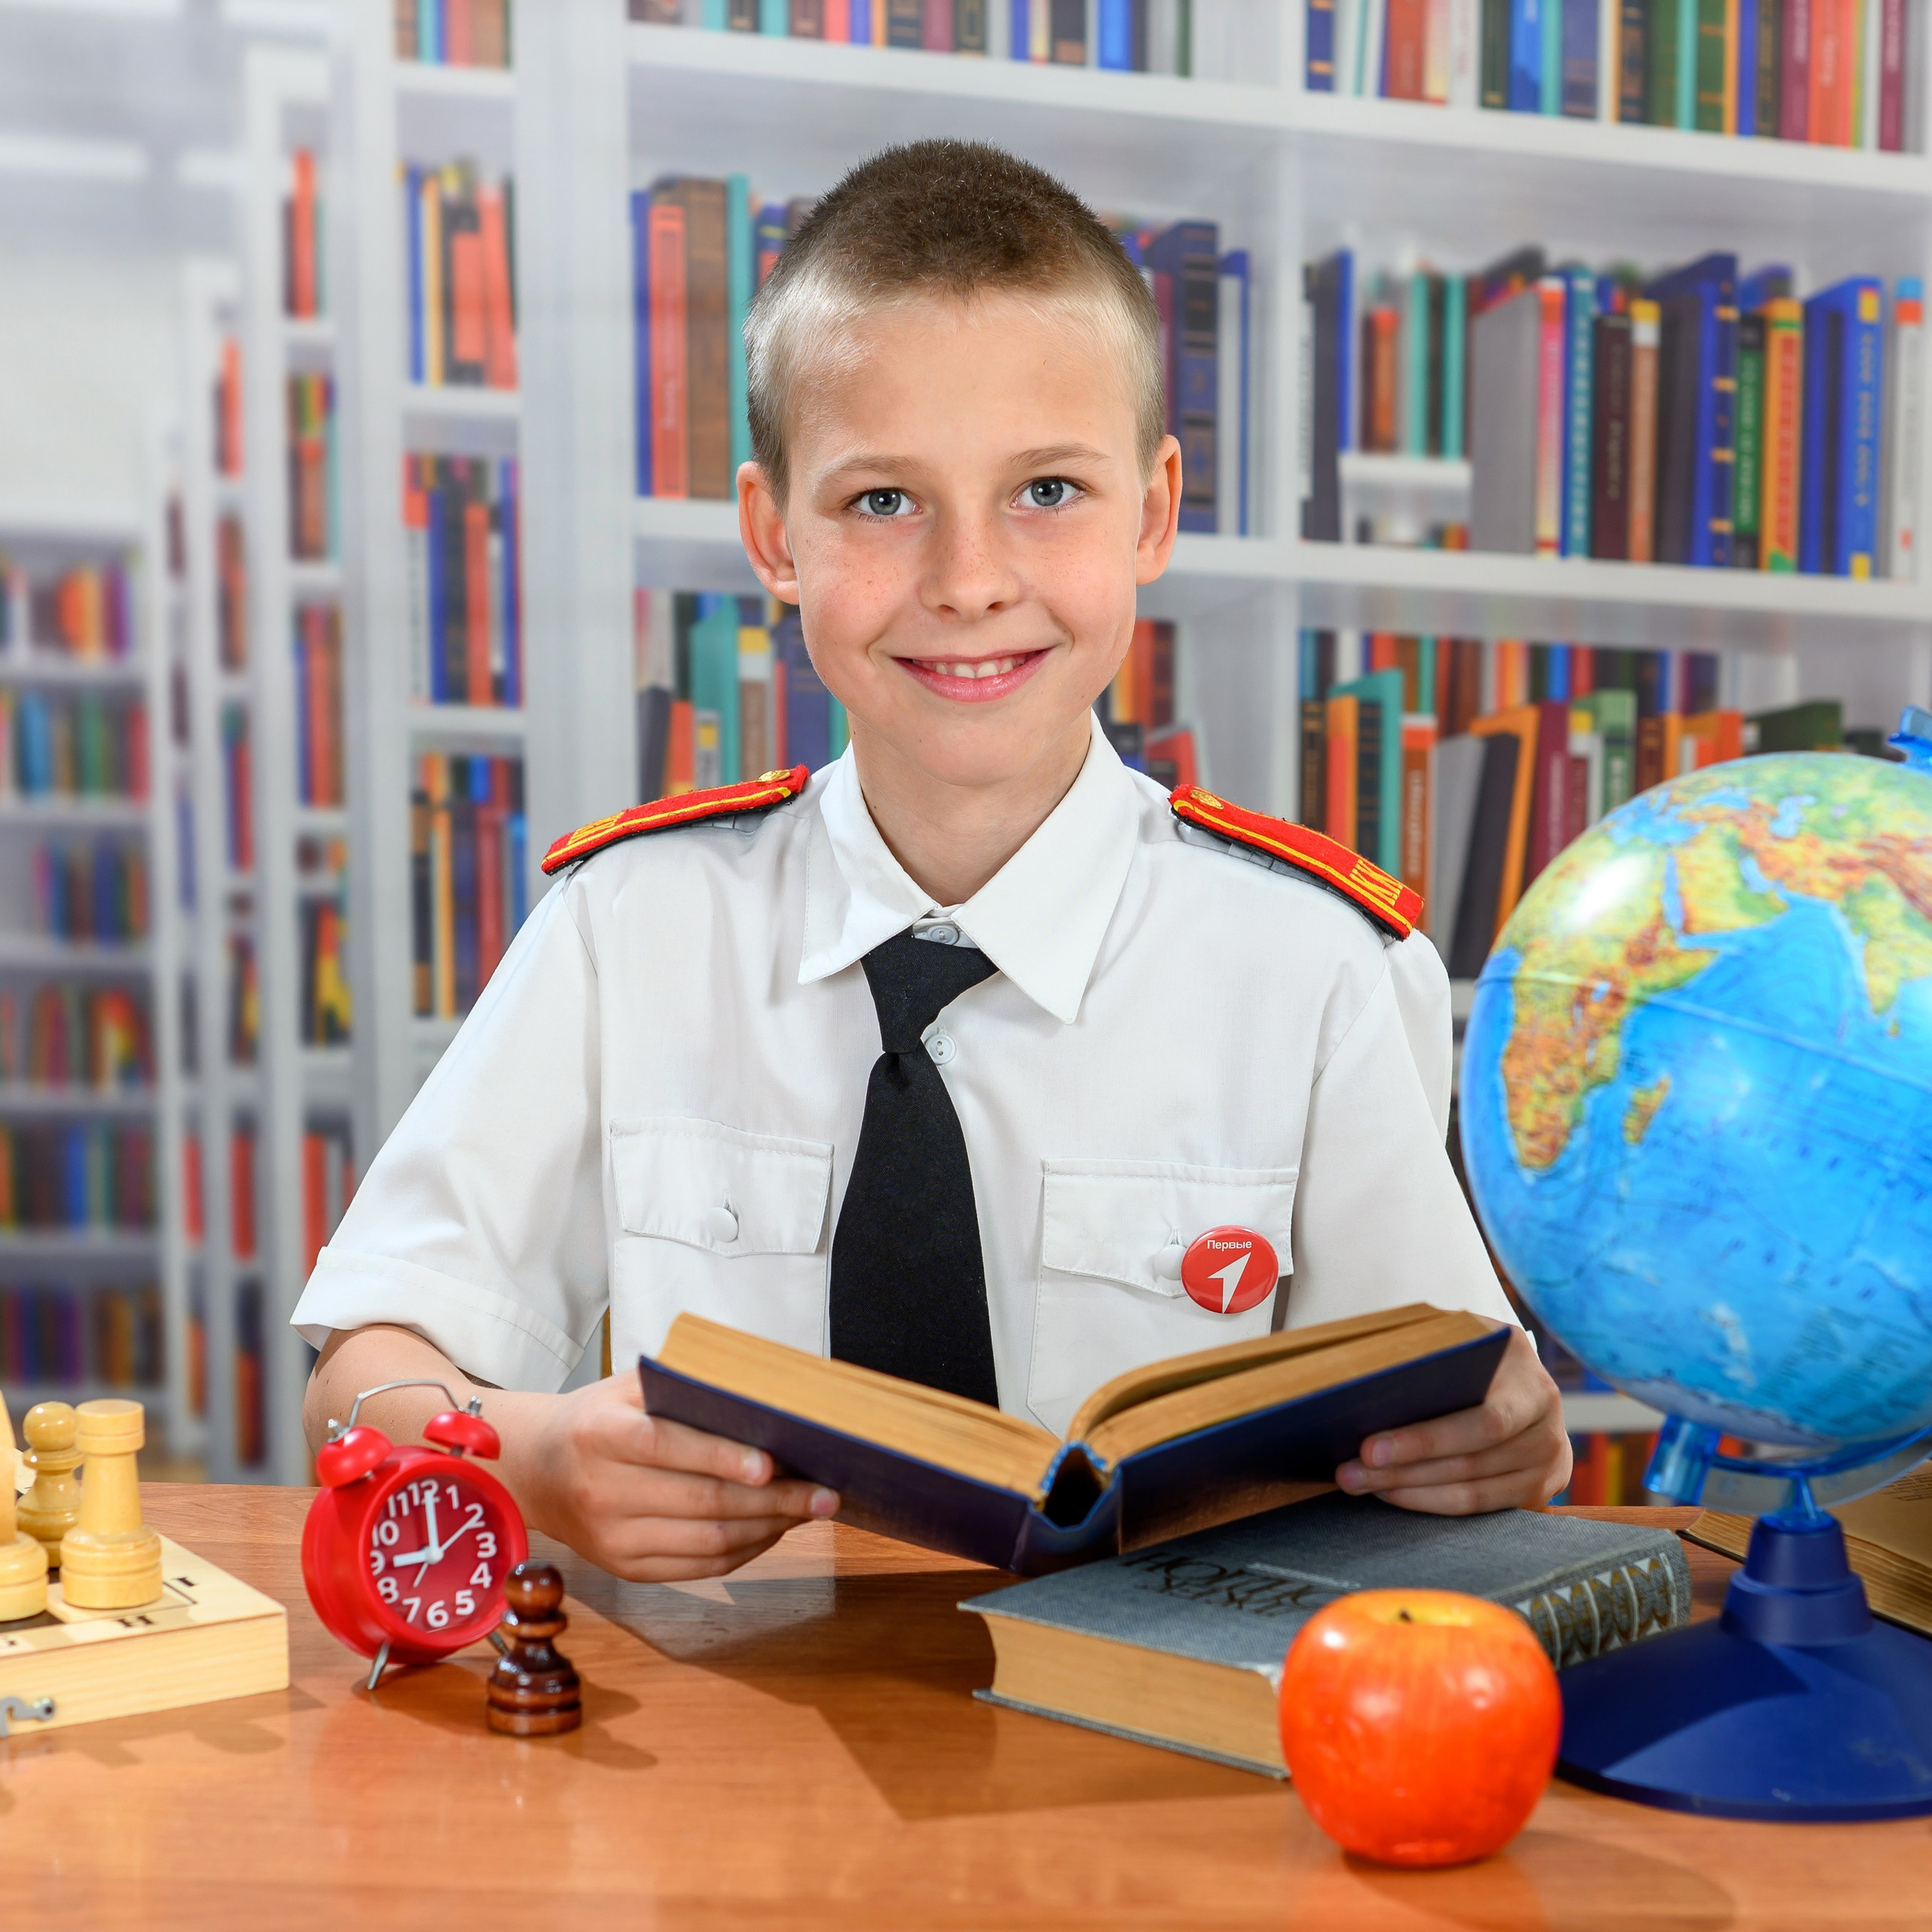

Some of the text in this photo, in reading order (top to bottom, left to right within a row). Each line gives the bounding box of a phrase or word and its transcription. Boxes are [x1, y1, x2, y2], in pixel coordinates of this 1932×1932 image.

[1208, 1240, 1253, 1252] Первые
[387, 1491, 410, 1518] 11
[407, 1478, 441, 1507] 12
[446, 1484, 460, 1509] 1
[465, 1503, 486, 1529] 2
[372, 1519, 400, 1547] 10
[475, 1531, 497, 1558] 3
[469, 1561, 493, 1589] 4
[377, 1576, 399, 1604] 8
[455, 1589, 475, 1616] 5
[402, 1597, 421, 1623] 7
[426, 1600, 449, 1628] 6
